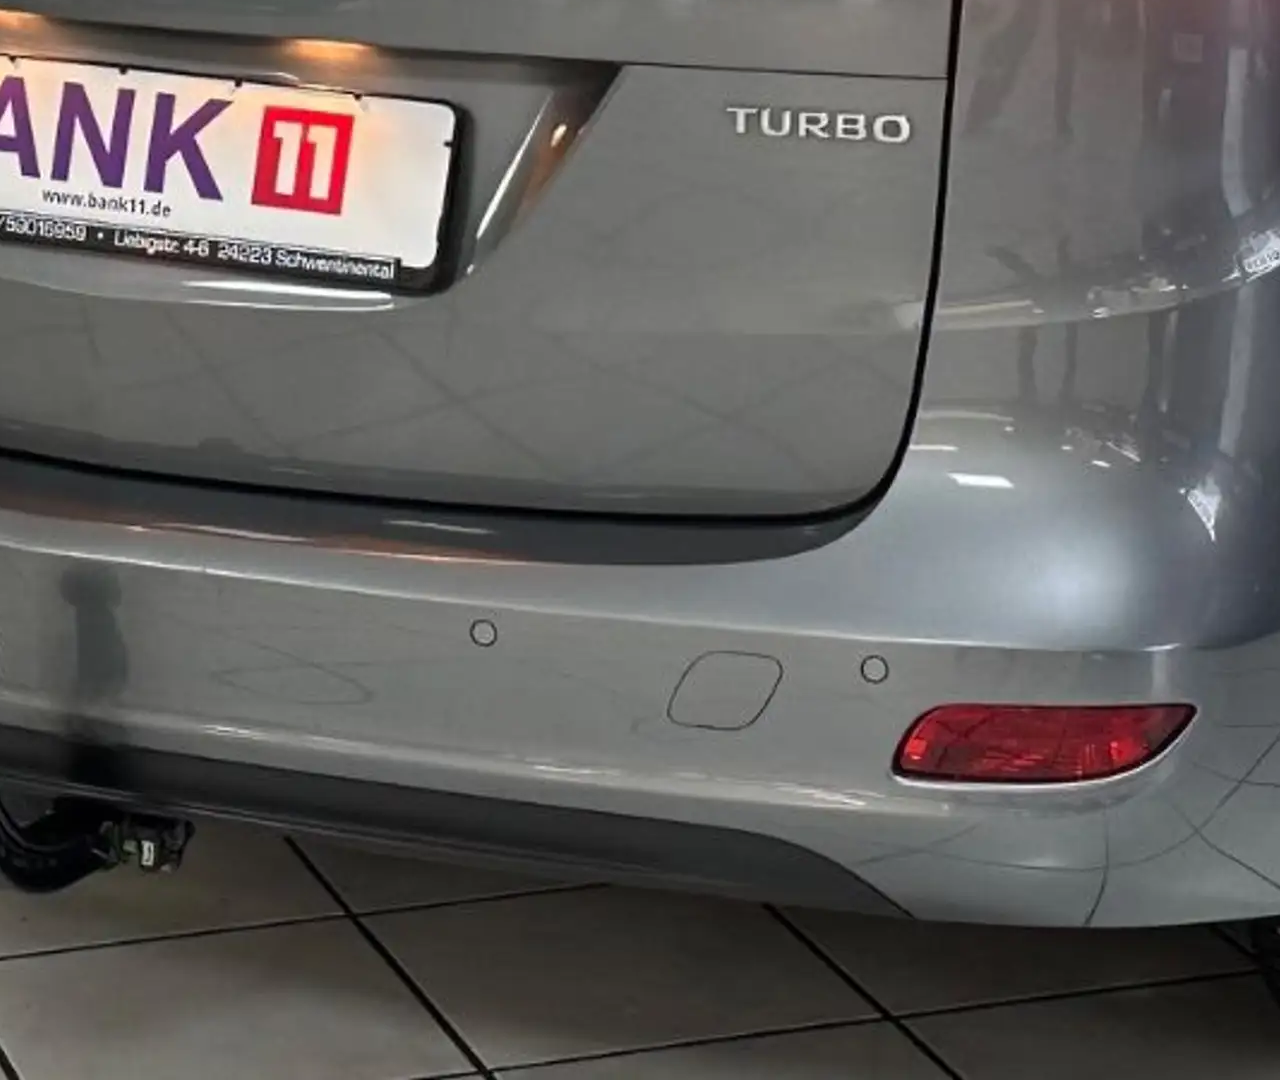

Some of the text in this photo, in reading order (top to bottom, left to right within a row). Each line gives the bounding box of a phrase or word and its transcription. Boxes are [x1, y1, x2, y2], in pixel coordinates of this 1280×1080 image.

[726, 107, 911, 144] TURBO
[271, 121, 338, 201] 11
[42, 187, 172, 218] www.bank11.de
[217, 242, 271, 266] 24223
[275, 248, 395, 280] Schwentinental
